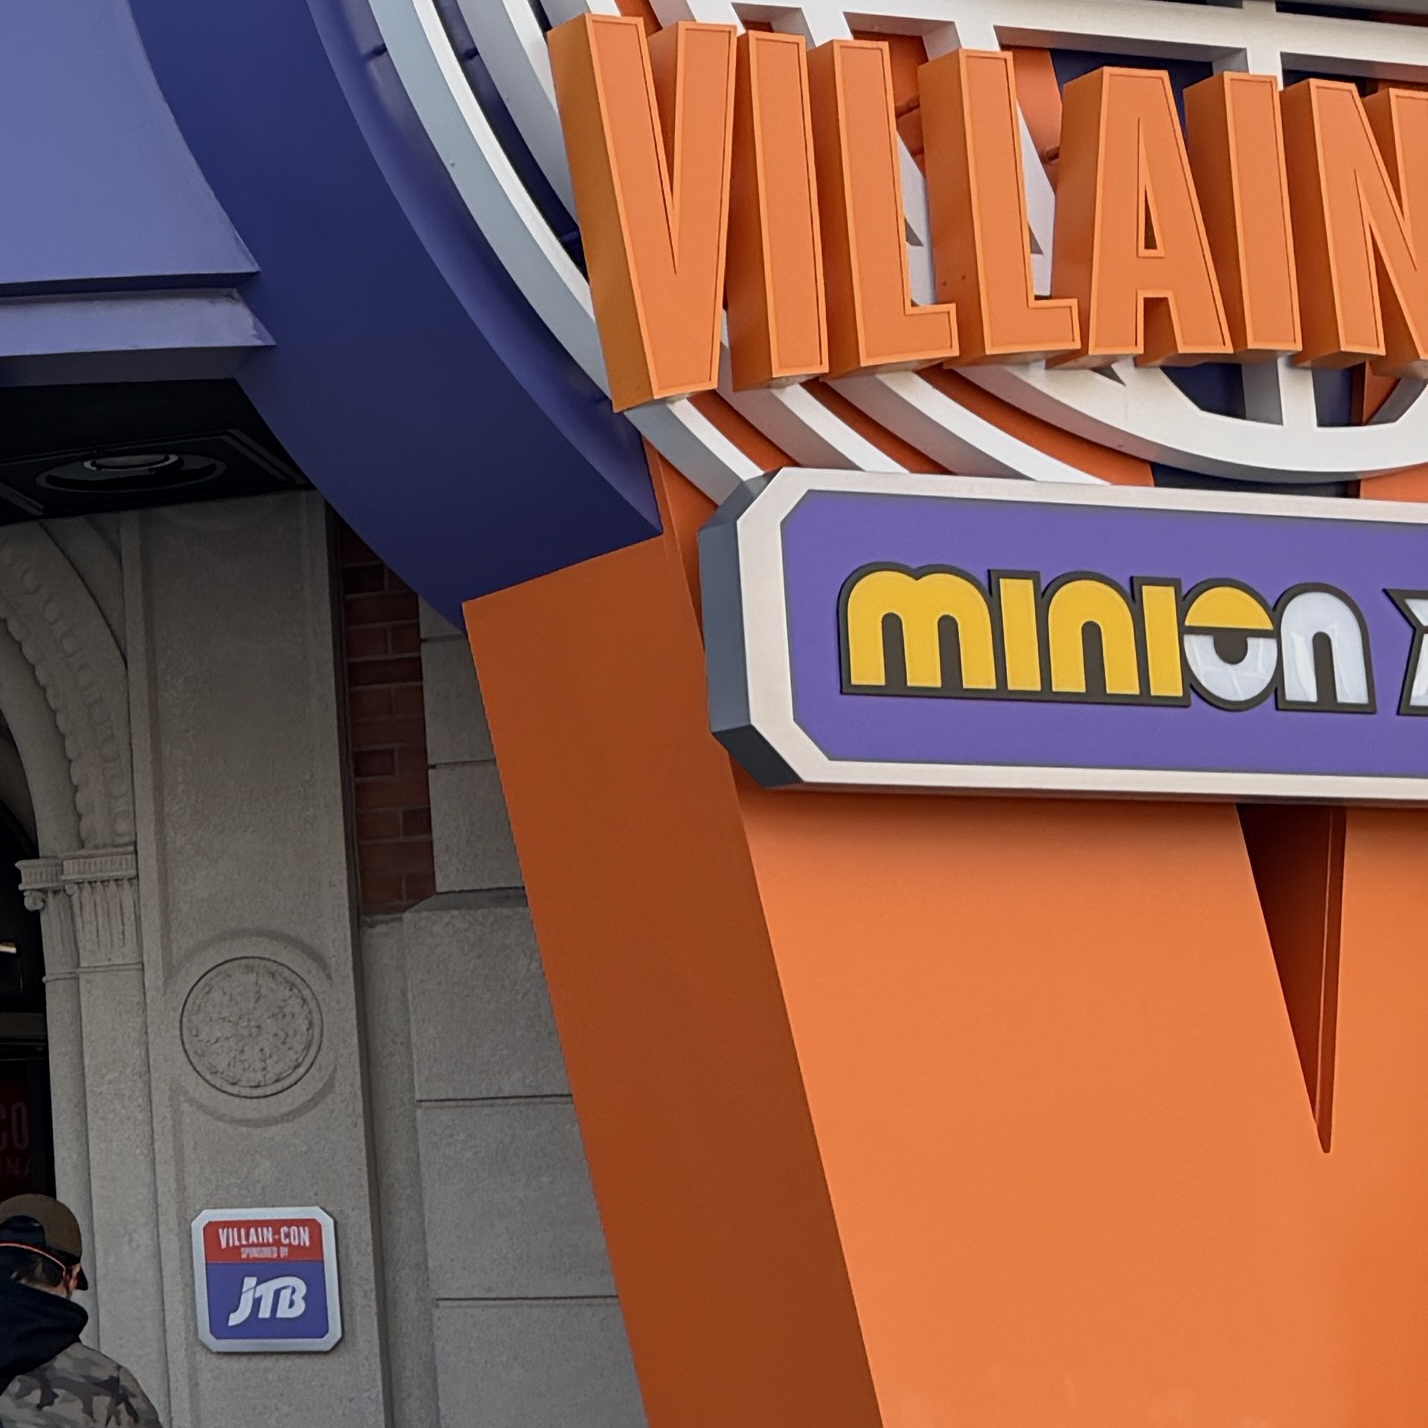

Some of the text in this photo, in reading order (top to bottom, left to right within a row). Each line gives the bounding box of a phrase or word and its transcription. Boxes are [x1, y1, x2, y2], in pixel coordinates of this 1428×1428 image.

[548, 13, 1428, 410] VILLAIN
[218, 1225, 310, 1249] VILLAIN-CON
[227, 1276, 307, 1327] JTB
